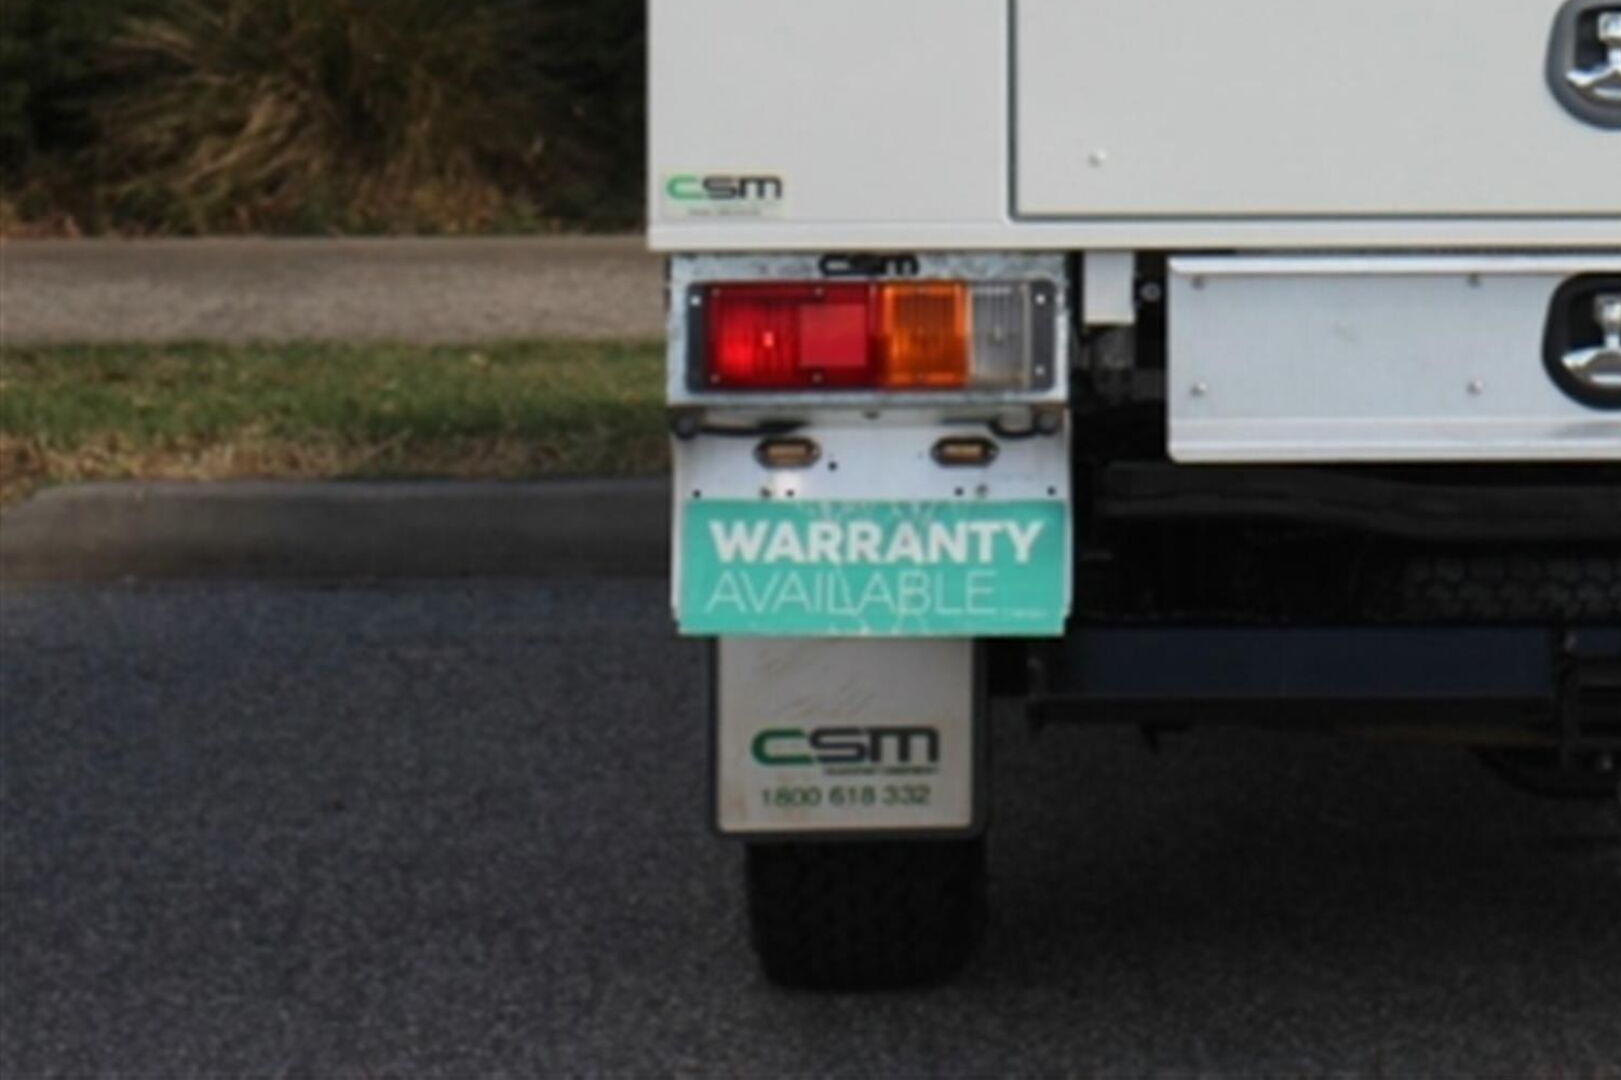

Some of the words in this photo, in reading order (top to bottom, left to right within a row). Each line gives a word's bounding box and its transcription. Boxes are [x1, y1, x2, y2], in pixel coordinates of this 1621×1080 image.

[709, 519, 1045, 564] WARRANTY
[705, 568, 1000, 616] AVAILABLE
[762, 786, 822, 806] 1800
[828, 786, 876, 805] 618
[881, 784, 931, 805] 332
